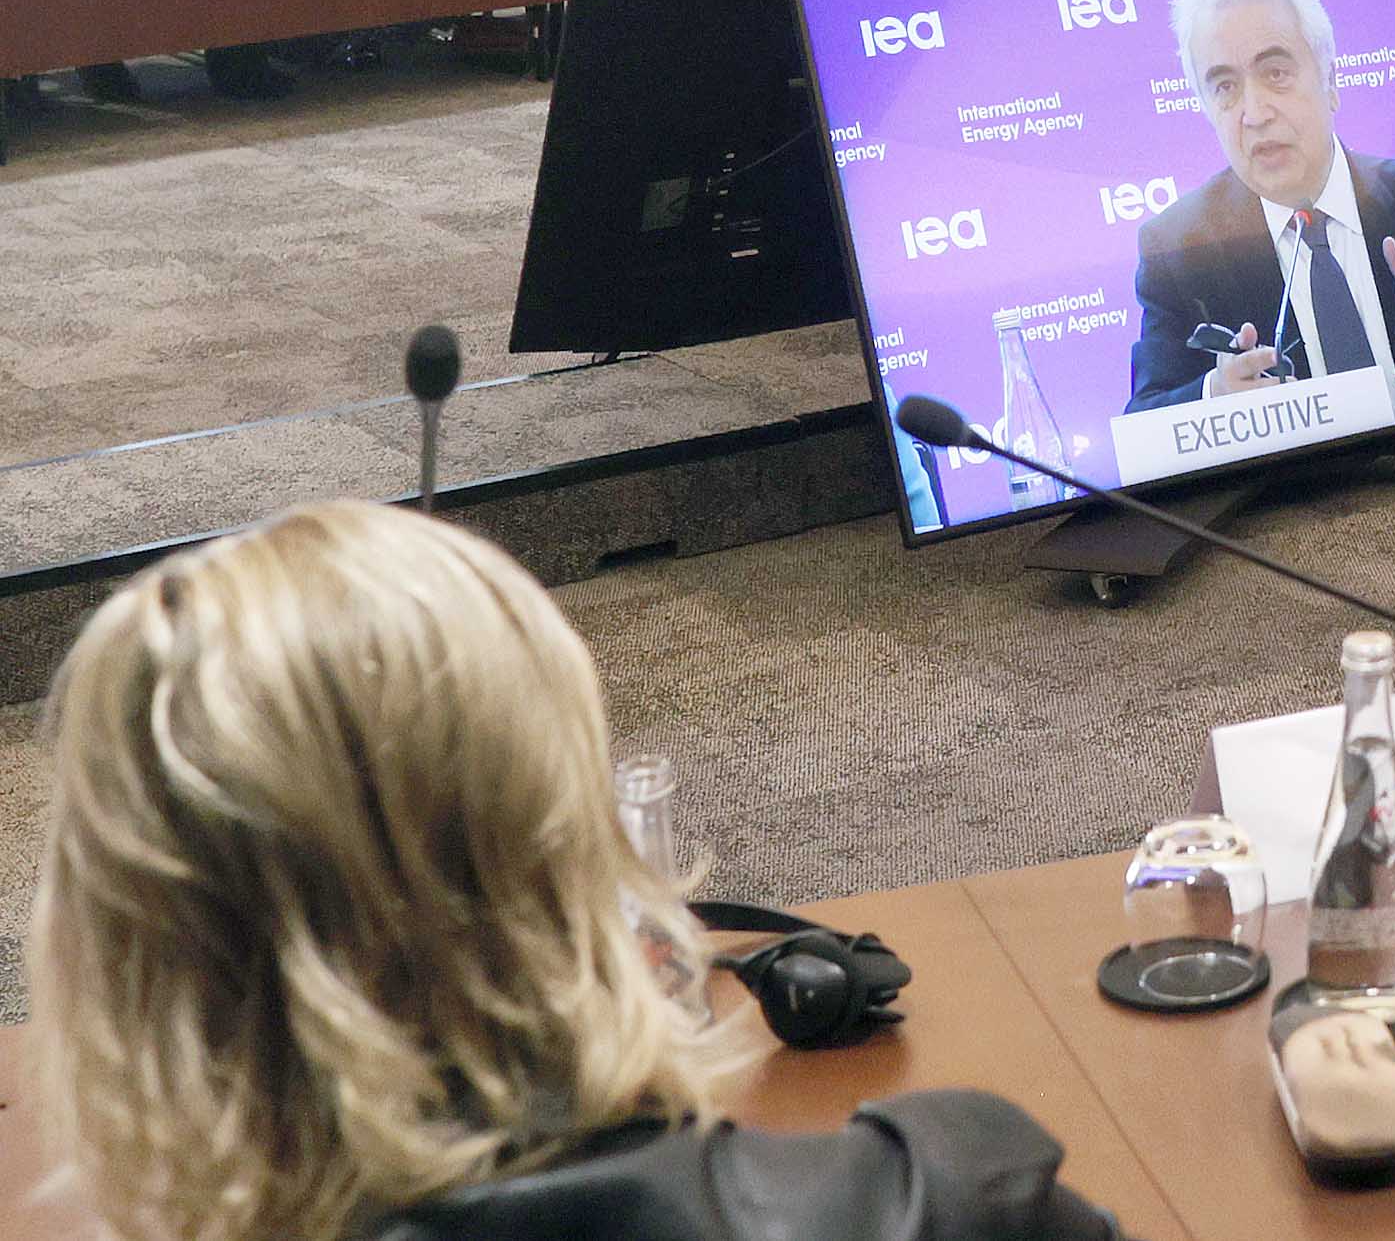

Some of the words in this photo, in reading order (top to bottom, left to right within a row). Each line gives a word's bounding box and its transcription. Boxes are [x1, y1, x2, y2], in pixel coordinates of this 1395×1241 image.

[860, 11, 945, 57] iea
[1335, 69, 1384, 88] Energy
[958, 92, 1062, 122] International
[1155, 97, 1201, 114] Energ
[962, 123, 1020, 143] Energy
[1023, 113, 1084, 137] Agency
[835, 143, 886, 167] gency
[1099, 176, 1178, 225] iea
[901, 208, 987, 259] iea
[1015, 289, 1105, 317] ternational
[1021, 323, 1063, 344] nergy
[1068, 309, 1128, 333] Agency
[878, 349, 928, 375] gency
[1172, 393, 1334, 454] EXECUTIVE
